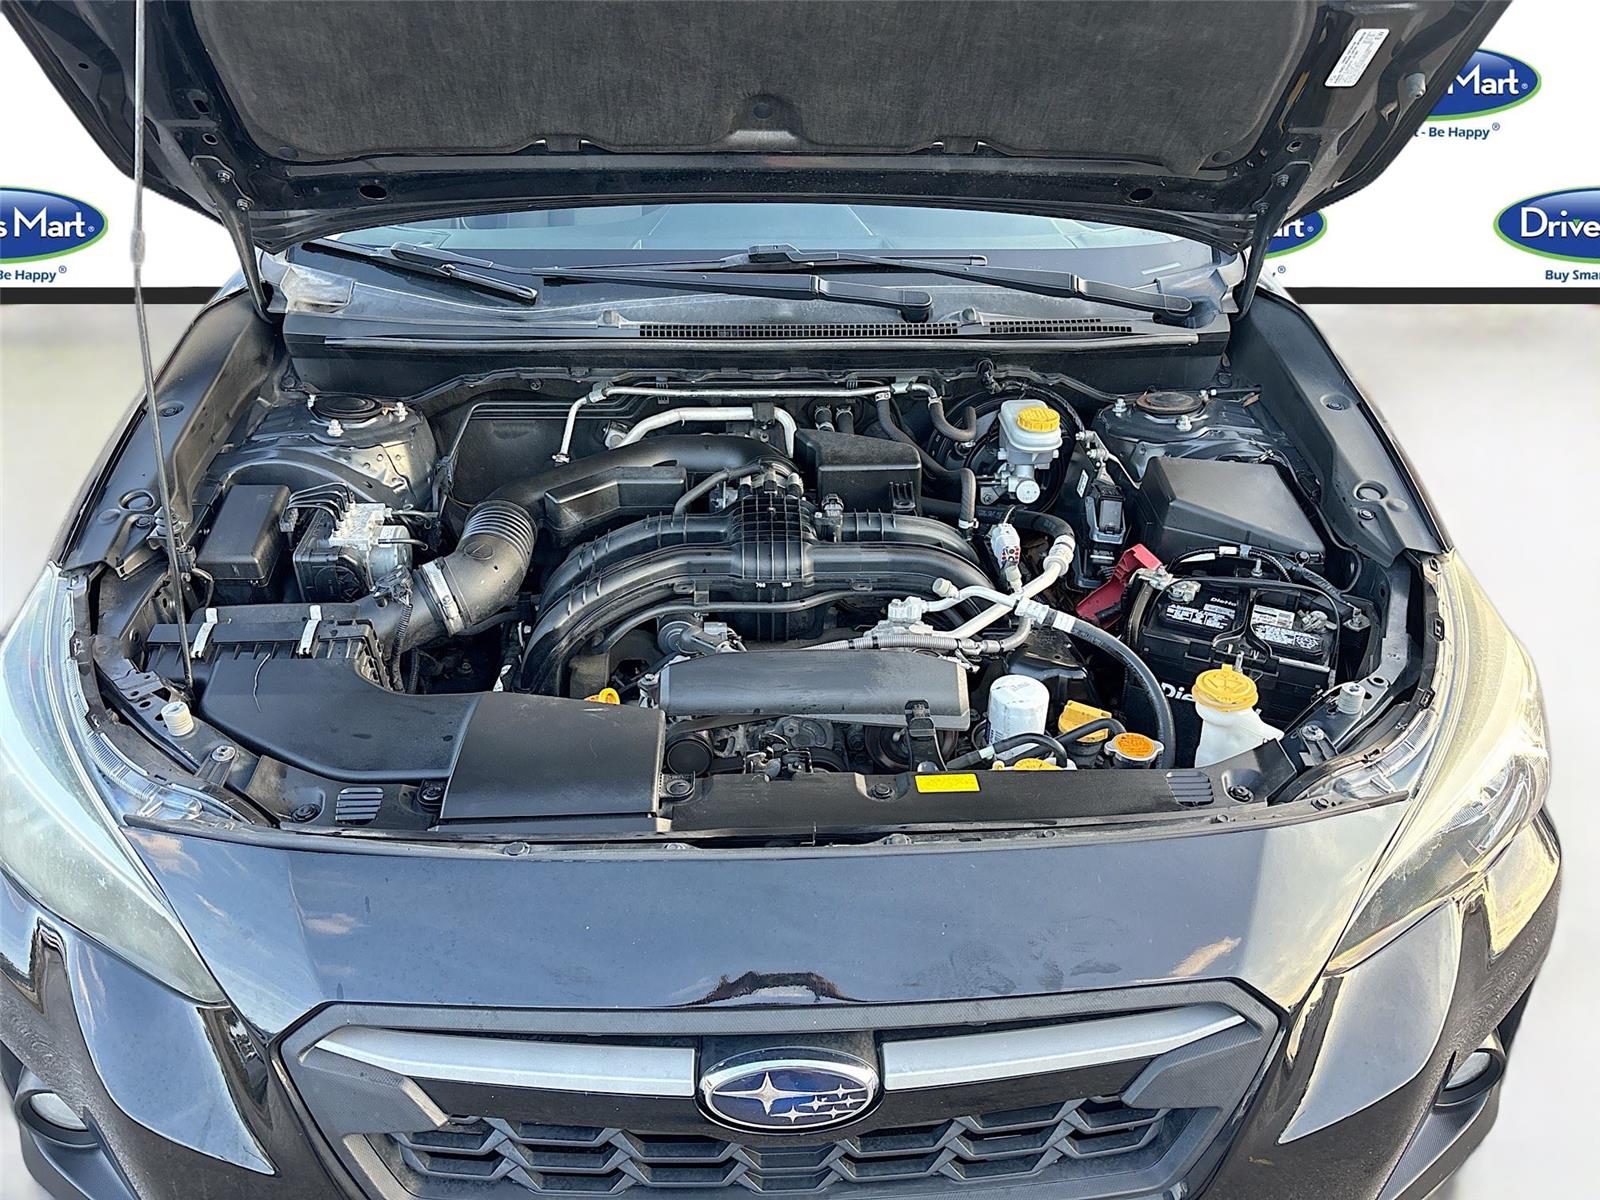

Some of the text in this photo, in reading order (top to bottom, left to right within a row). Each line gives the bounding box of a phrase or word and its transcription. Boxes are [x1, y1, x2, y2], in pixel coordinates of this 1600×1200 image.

[1428, 127, 1445, 138] Be
[1448, 127, 1490, 140] Happy
[14, 206, 86, 238] Mart
[1273, 219, 1305, 237] art
[1521, 206, 1600, 238] Drive
[15, 269, 57, 283] Happy
[1545, 269, 1600, 283] Buy Sma
